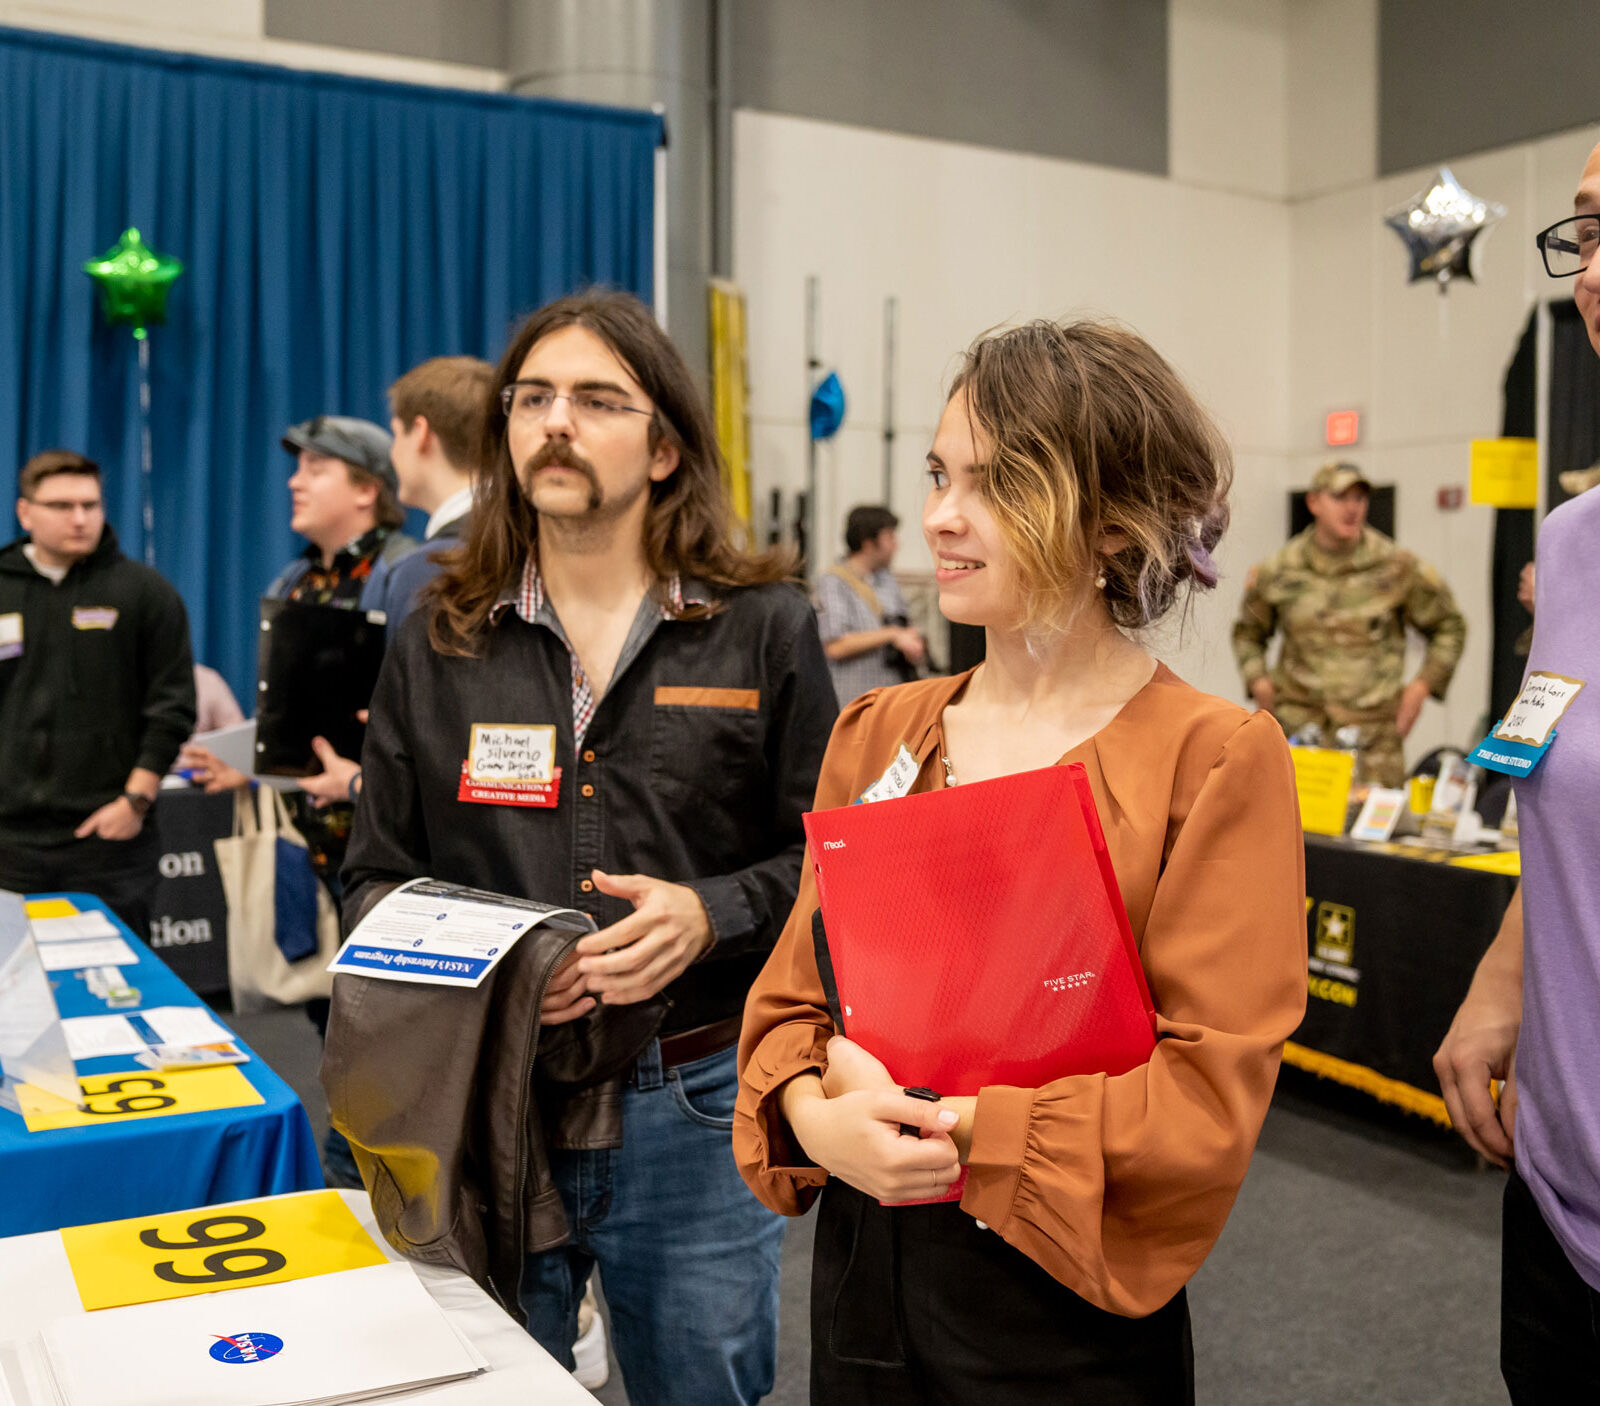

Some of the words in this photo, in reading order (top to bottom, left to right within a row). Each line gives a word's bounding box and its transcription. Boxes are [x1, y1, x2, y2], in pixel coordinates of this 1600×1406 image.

[471, 789, 516, 801] CREATIVE
[517, 793, 546, 803] MEDIA
[353, 950, 393, 965] Programs
[393, 952, 439, 970] Internship
[1043, 976, 1066, 988] FIVE
[235, 1333, 260, 1362] NASA
